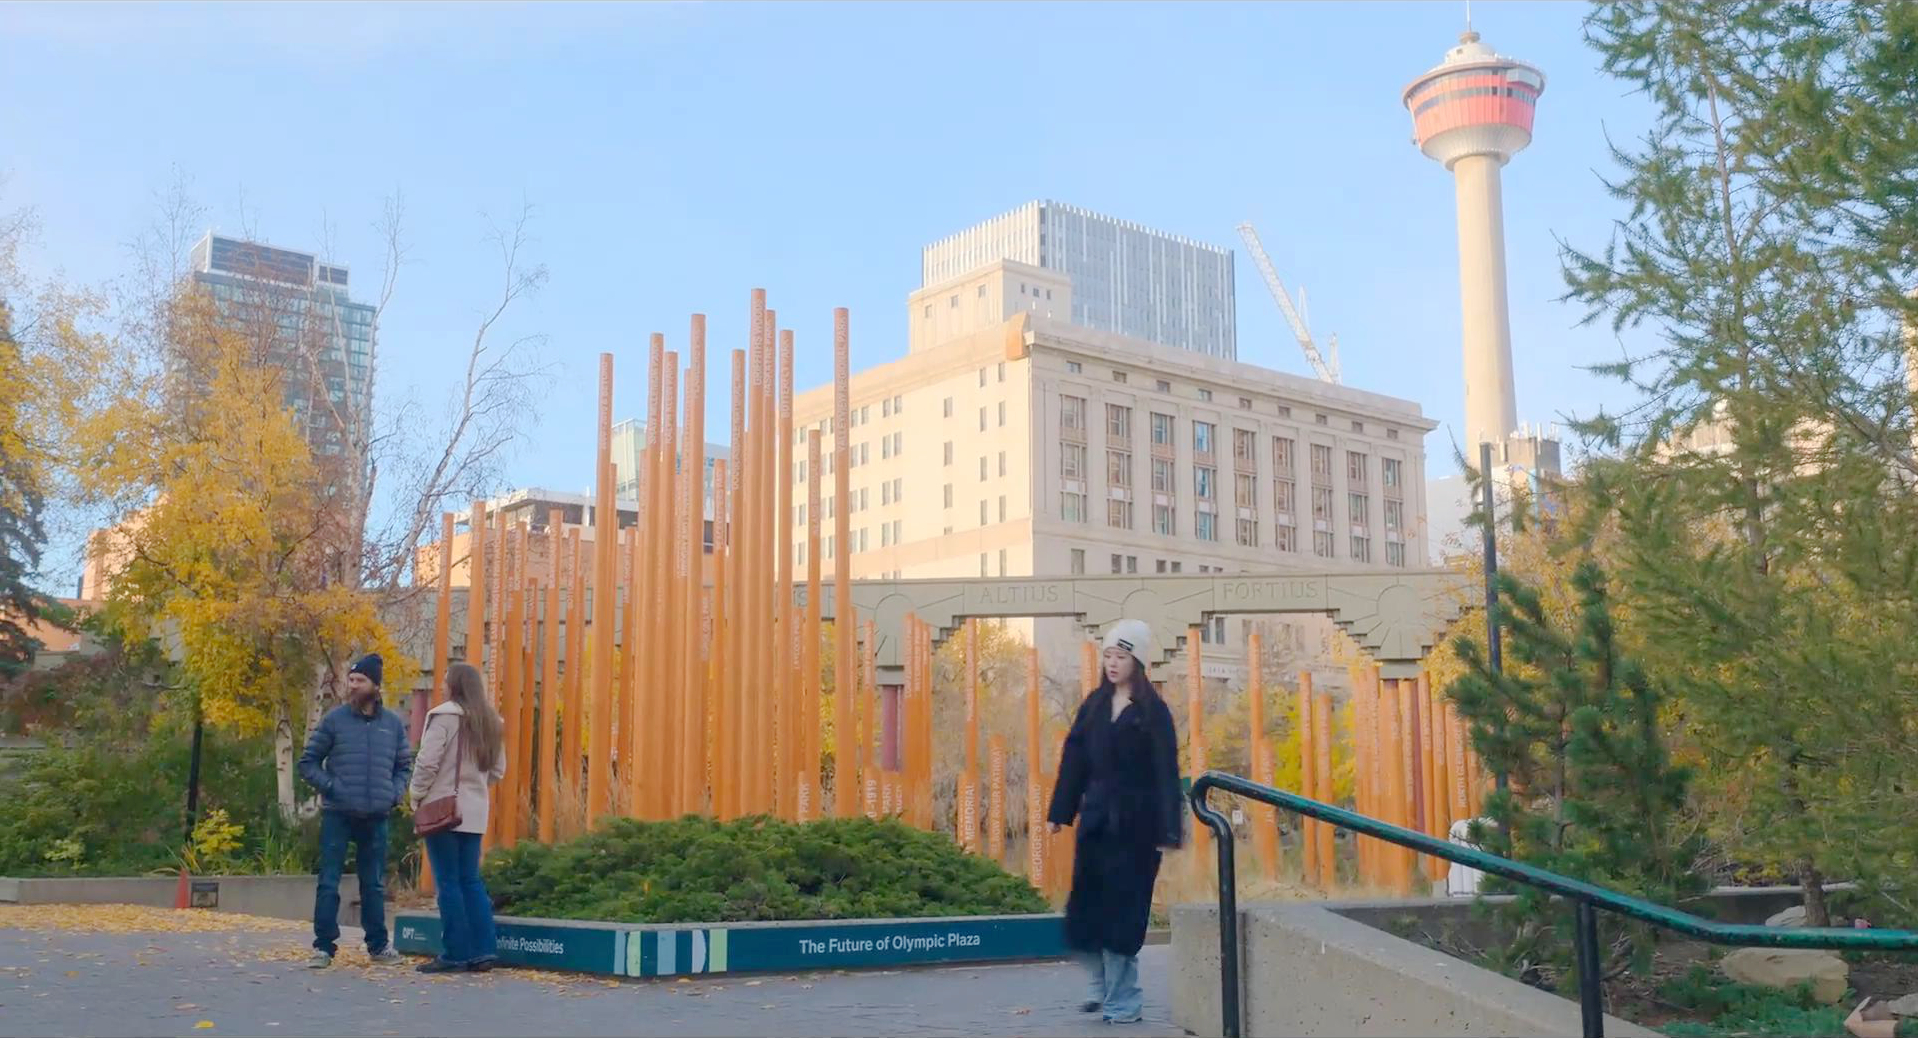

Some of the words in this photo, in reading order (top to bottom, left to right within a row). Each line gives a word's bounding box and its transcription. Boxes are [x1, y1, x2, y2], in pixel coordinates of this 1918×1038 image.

[838, 315, 847, 343] PARK
[980, 585, 1059, 603] ALTIUS
[1223, 581, 1318, 600] FORTIUS
[992, 747, 1001, 789] PATHWAY
[800, 783, 809, 812] PARK
[882, 783, 892, 813] PARK
[965, 782, 975, 840] MEMORIAL
[992, 791, 1001, 818] RIVER
[1032, 784, 1041, 822] ISLAND
[496, 935, 519, 950] nfinite
[520, 936, 564, 954] Possibilities
[799, 939, 825, 954] The
[829, 938, 873, 953] Future
[876, 937, 889, 950] of
[892, 934, 945, 952] Olympic
[947, 933, 981, 947] Plaza
